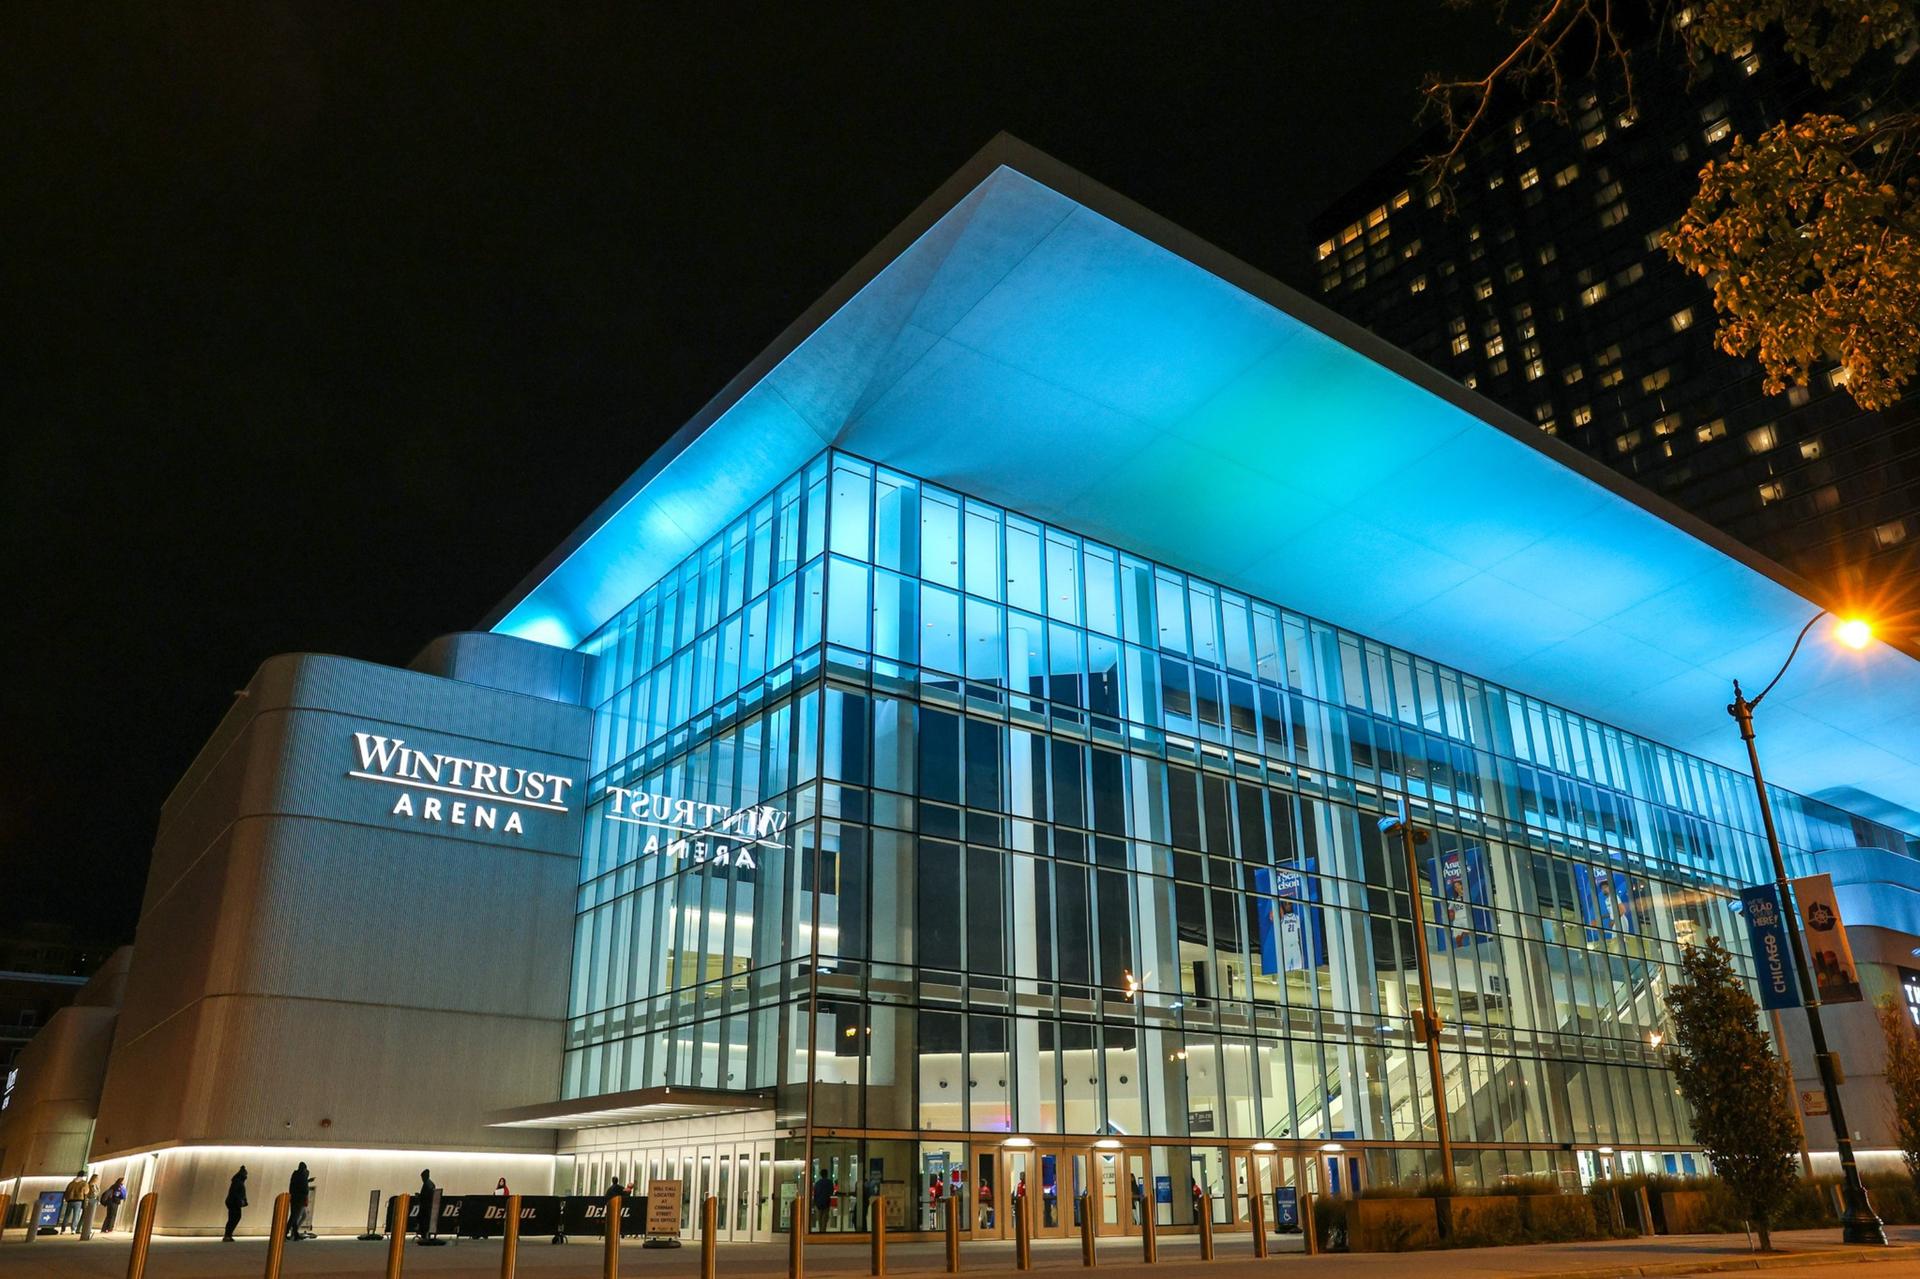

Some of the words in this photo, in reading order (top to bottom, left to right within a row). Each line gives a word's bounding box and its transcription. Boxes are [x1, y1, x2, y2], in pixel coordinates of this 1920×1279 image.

[353, 732, 573, 804] WINTRUST
[392, 792, 524, 834] ARENA
[1749, 902, 1773, 913] GLAD
[1764, 935, 1787, 993] CHICAGO
